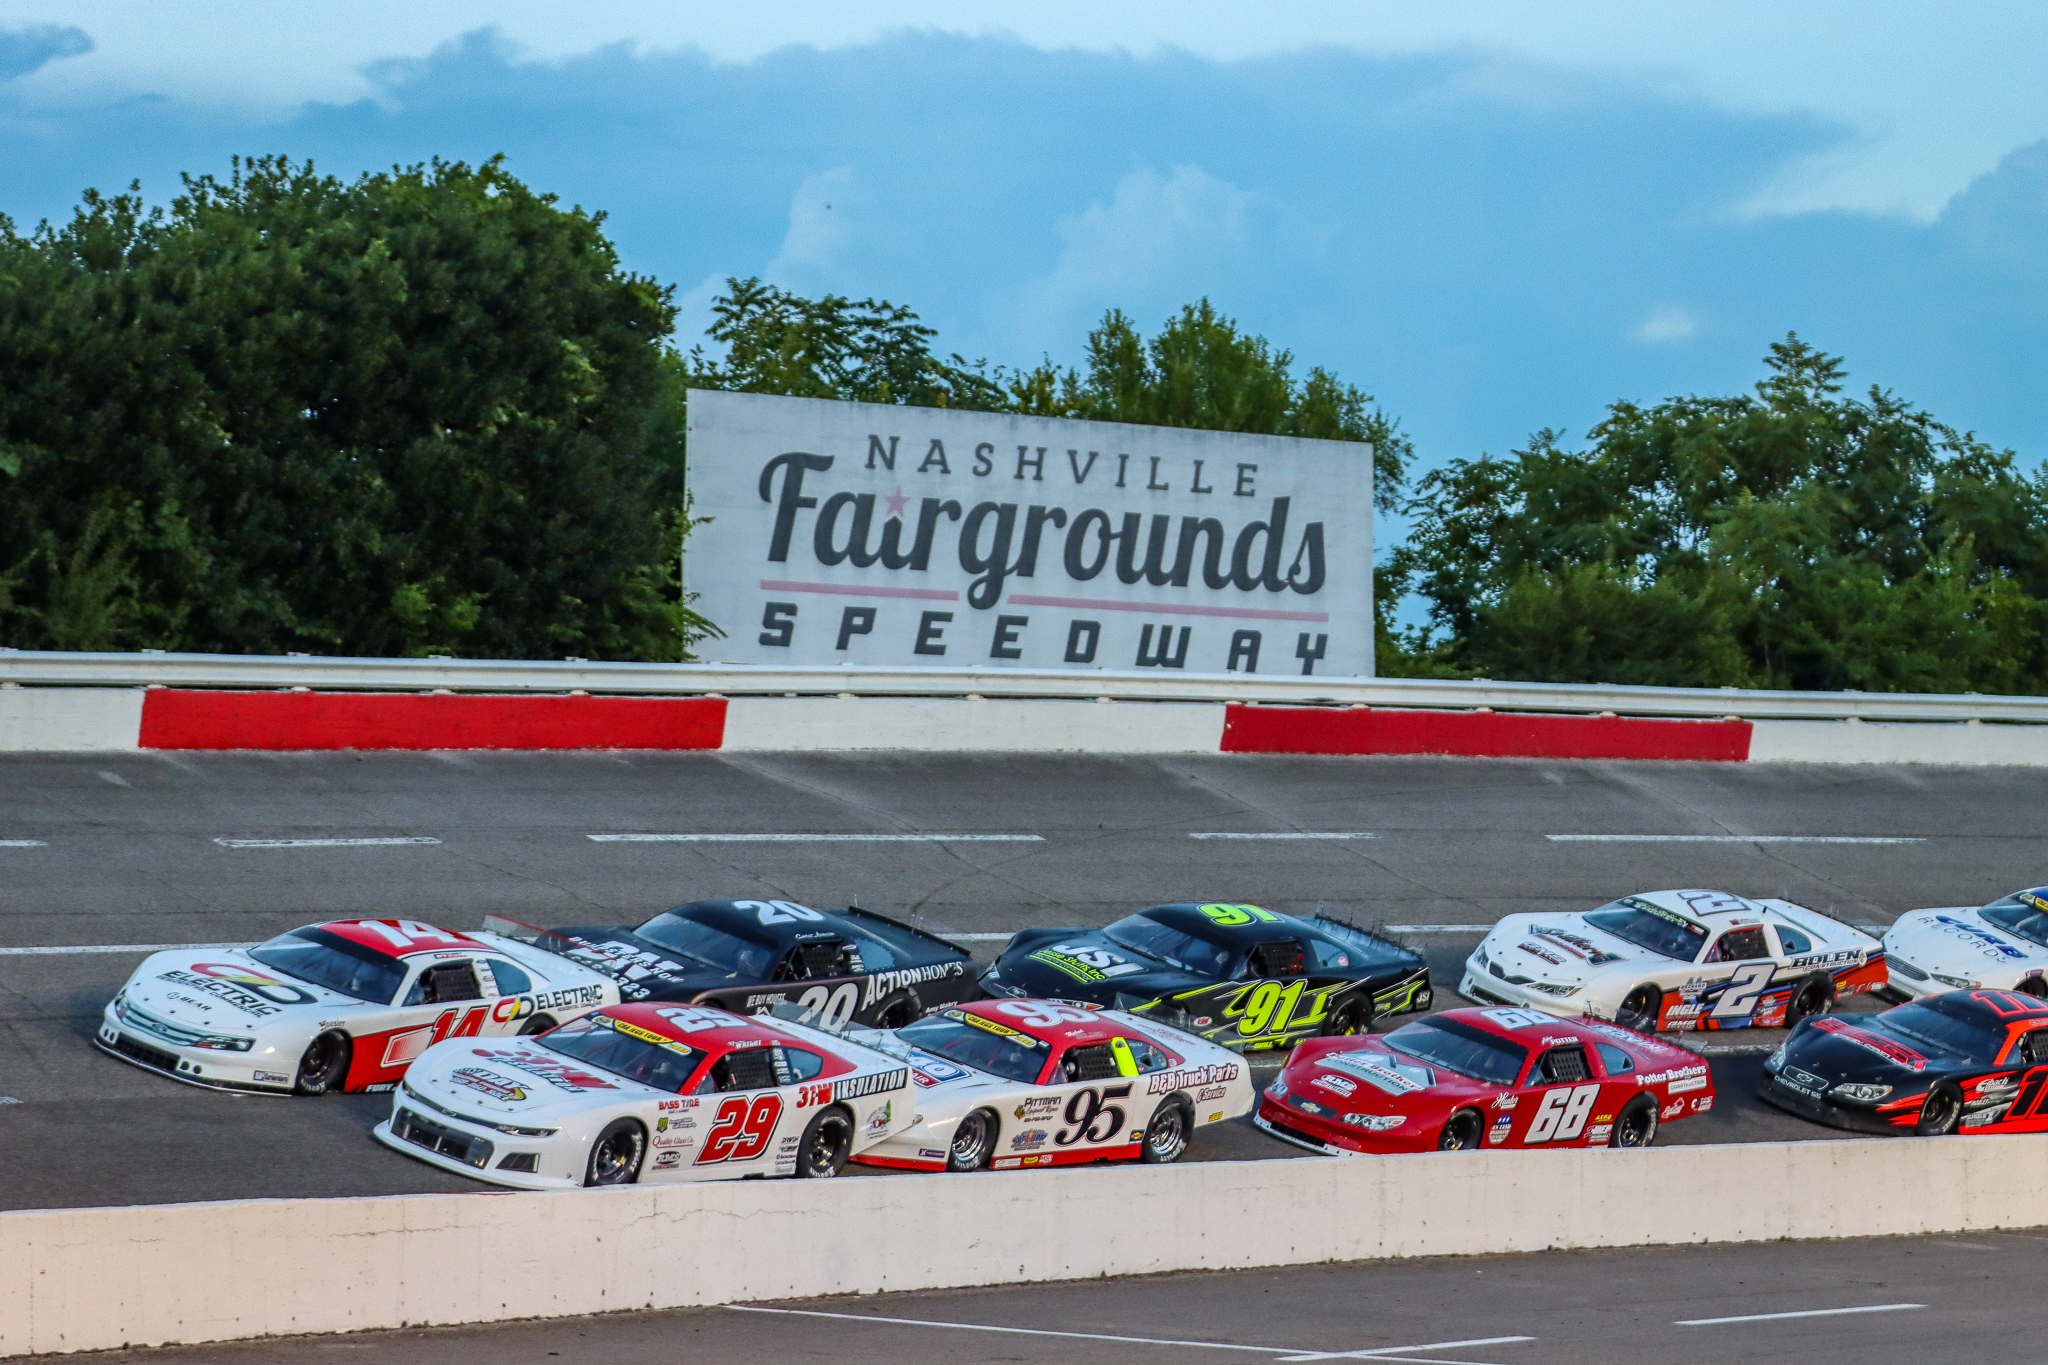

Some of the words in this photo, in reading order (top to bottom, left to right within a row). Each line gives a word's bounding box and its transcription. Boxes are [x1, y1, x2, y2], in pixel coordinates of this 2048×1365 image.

[864, 434, 1259, 497] NASHVILLE
[758, 451, 1327, 610] Fairgrounds
[758, 601, 1328, 675] SPEEDWAY
[732, 900, 825, 925] 20
[1198, 903, 1285, 927] 91
[359, 919, 459, 948] 14
[1917, 916, 2011, 963] RECORDS
[1052, 944, 1144, 978] JSI
[1789, 947, 1863, 969] BOLEN
[648, 967, 685, 983] NOW
[163, 970, 283, 1015] ELECTRIC
[535, 984, 604, 1011] ELECTRIC
[1709, 962, 1778, 1018] 2
[797, 982, 860, 1034] 20
[1237, 978, 1309, 1037] 91
[1666, 1003, 1705, 1016] INGLE
[428, 1004, 492, 1046] 14
[735, 1040, 762, 1049] WRIGHT
[1550, 1036, 1578, 1044] POTTER
[836, 1068, 905, 1099] INSULATION
[1176, 1066, 1209, 1089] Truck
[1208, 1063, 1239, 1082] Parts
[1635, 1073, 1667, 1086] Potter
[1665, 1065, 1707, 1080] Brothers
[1774, 1075, 1811, 1095] CHEVROLET
[658, 1100, 680, 1110] BASS
[1024, 1096, 1062, 1107] PITTMAN
[1202, 1085, 1227, 1100] Service
[1053, 1081, 1134, 1147] 95
[1523, 1084, 1601, 1144] 68
[652, 1135, 673, 1149] Quality
[693, 1091, 785, 1166] 29
